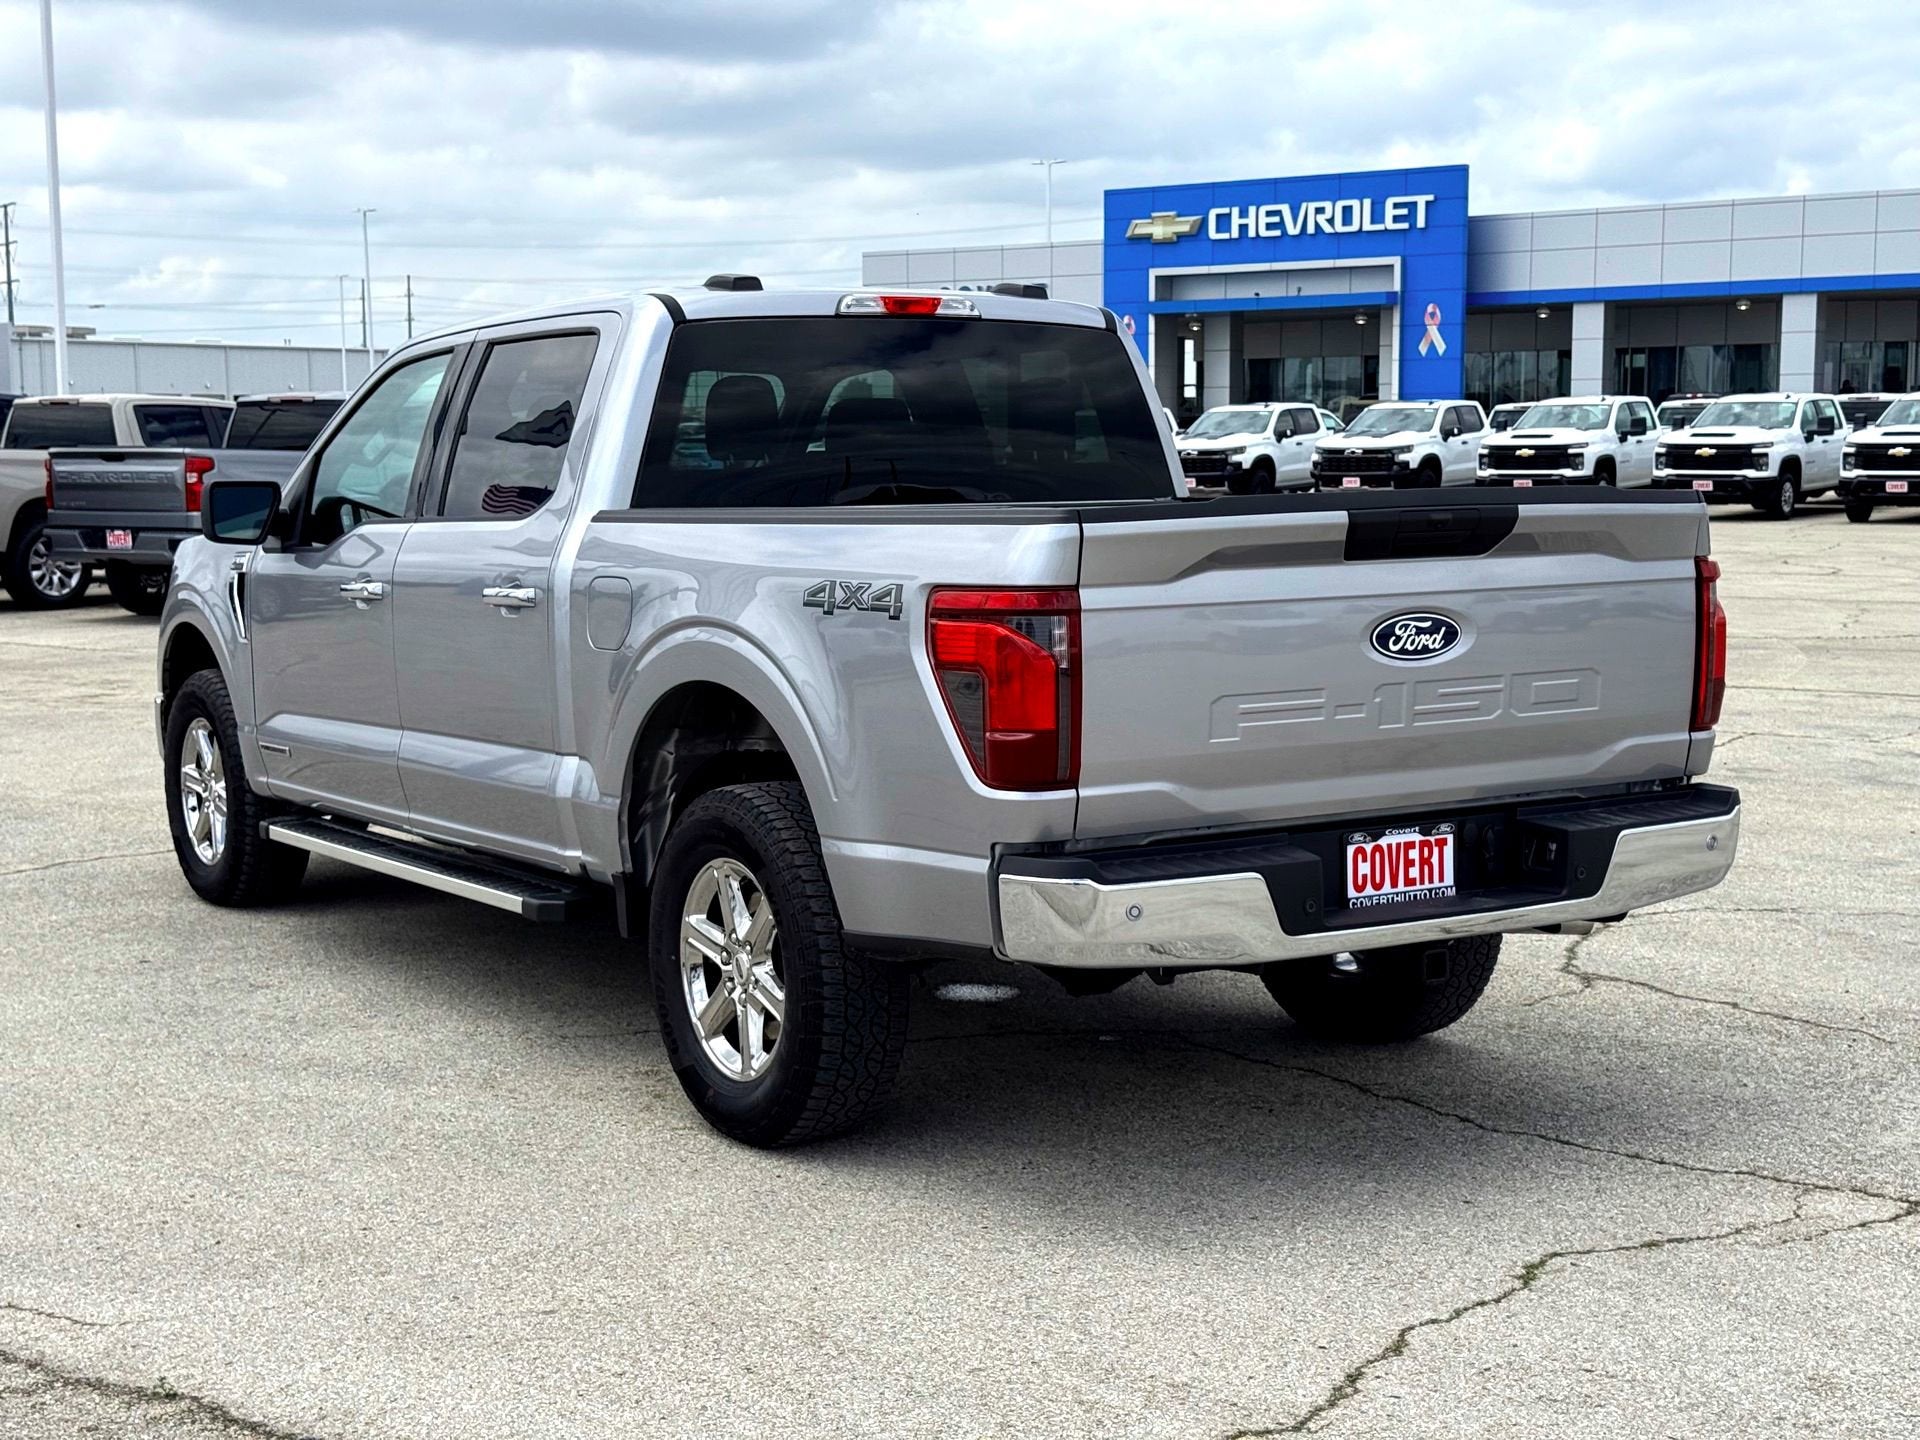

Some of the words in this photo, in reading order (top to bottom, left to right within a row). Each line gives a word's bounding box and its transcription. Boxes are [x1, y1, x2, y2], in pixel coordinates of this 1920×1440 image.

[1207, 194, 1435, 240] CHEVROLET
[57, 472, 172, 483] CHEVROLET
[1388, 620, 1446, 652] Ford
[1209, 667, 1601, 742] F-150
[1385, 826, 1420, 836] Covert
[1352, 838, 1448, 894] COVERT
[1349, 886, 1457, 909] COVERTHUTTOCOM
